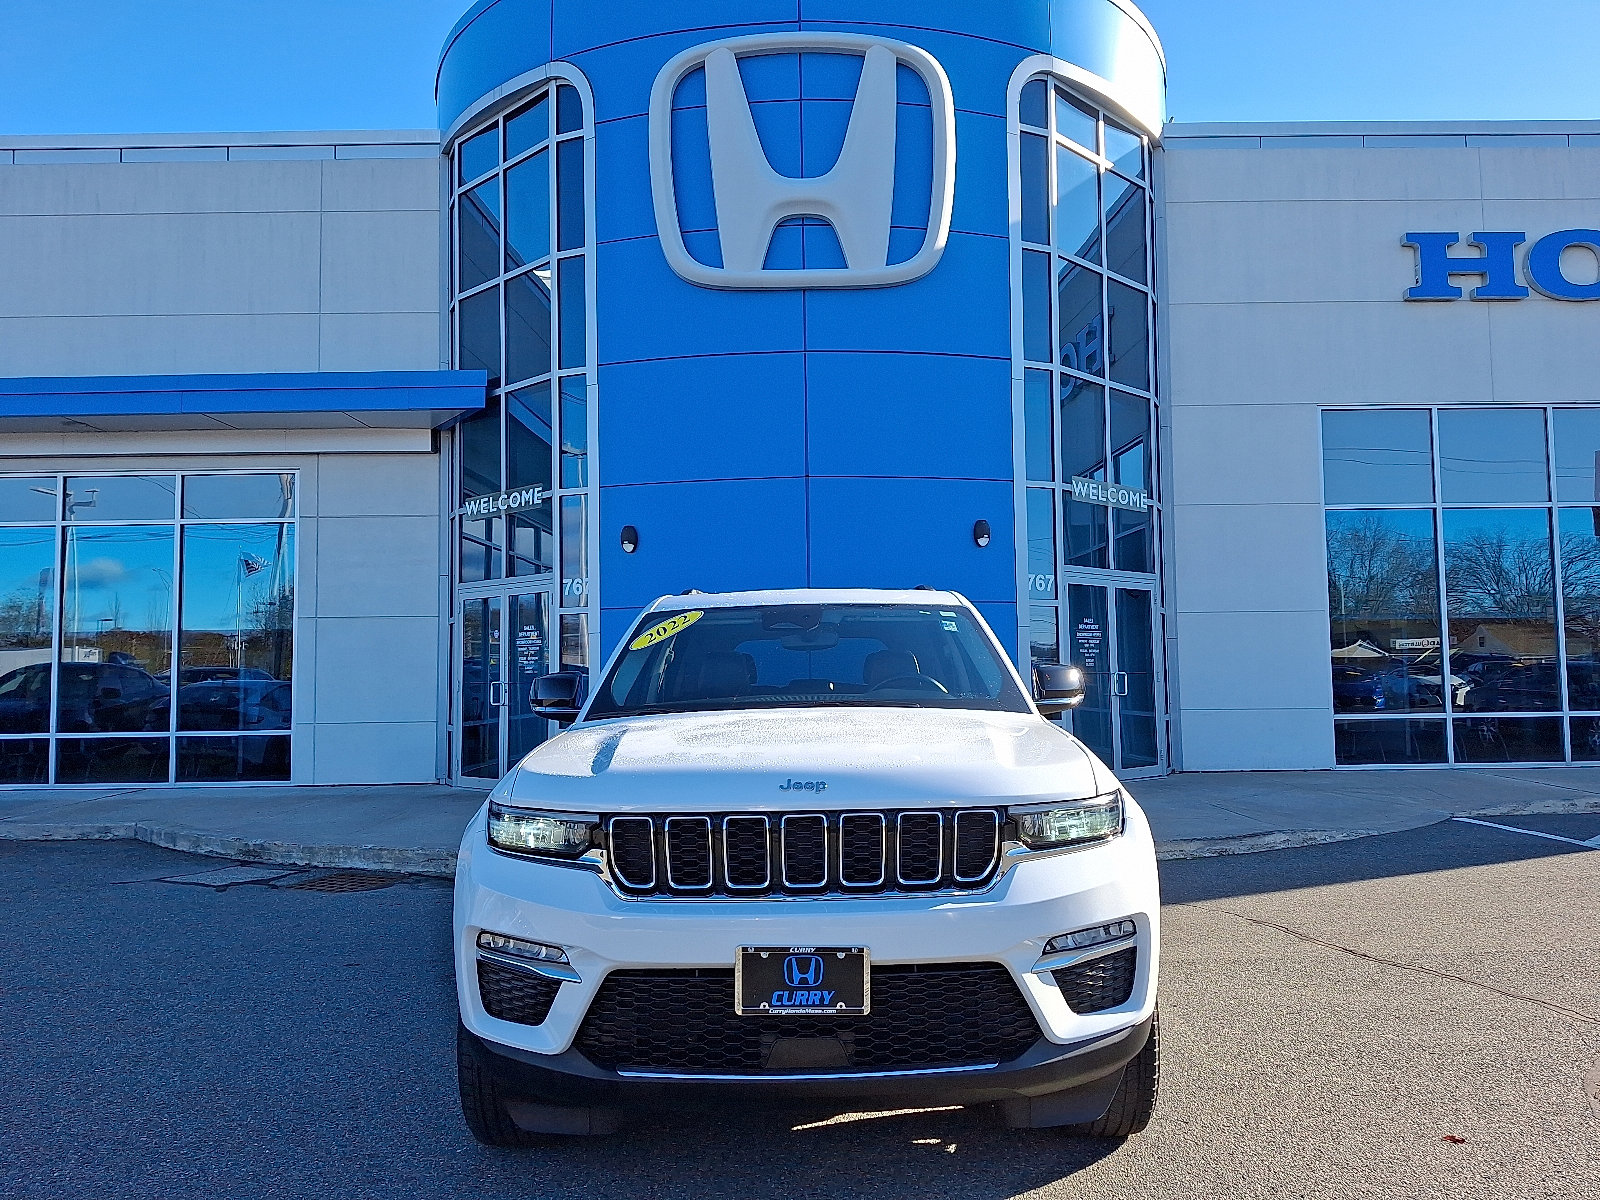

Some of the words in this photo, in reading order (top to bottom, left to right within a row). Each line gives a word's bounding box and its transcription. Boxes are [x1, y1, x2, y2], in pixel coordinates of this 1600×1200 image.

[1401, 229, 1600, 301] HO
[465, 487, 543, 516] WELCOME
[1072, 479, 1148, 508] WELCOME
[1028, 573, 1055, 592] 767
[645, 615, 690, 643] 2022
[779, 778, 827, 794] Jeep
[771, 990, 835, 1006] CURRY
